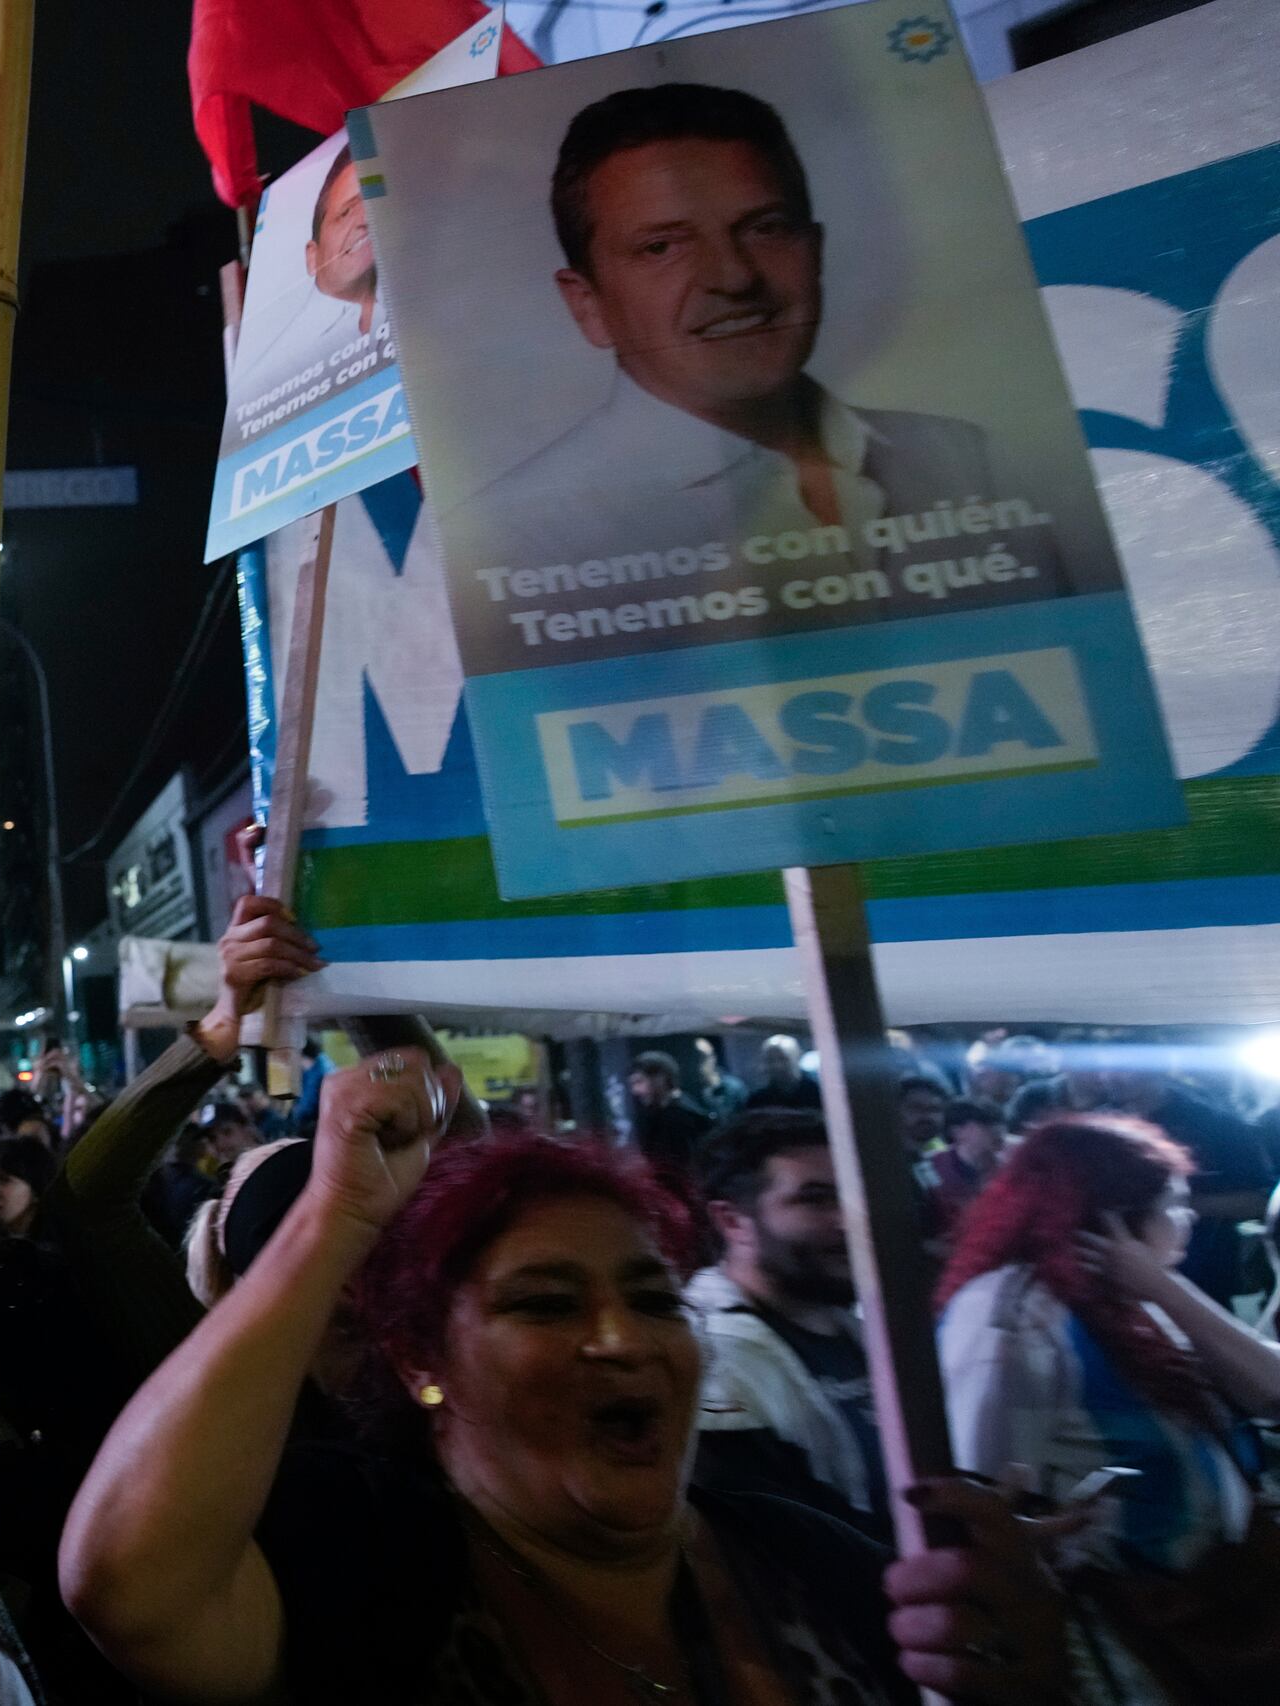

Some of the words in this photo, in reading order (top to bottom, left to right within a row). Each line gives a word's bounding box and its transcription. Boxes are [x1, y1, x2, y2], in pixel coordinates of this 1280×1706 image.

[234, 361, 325, 422] Tenemos
[329, 333, 370, 367] con
[240, 377, 331, 439] Tenemos
[336, 351, 378, 385] con
[475, 539, 731, 601] Tenemos
[743, 523, 850, 565] con
[865, 496, 1051, 555] quién.
[510, 582, 769, 646] Tenemos
[780, 566, 890, 610] con
[903, 543, 1040, 601] qué.
[565, 669, 1066, 802] MASSA
